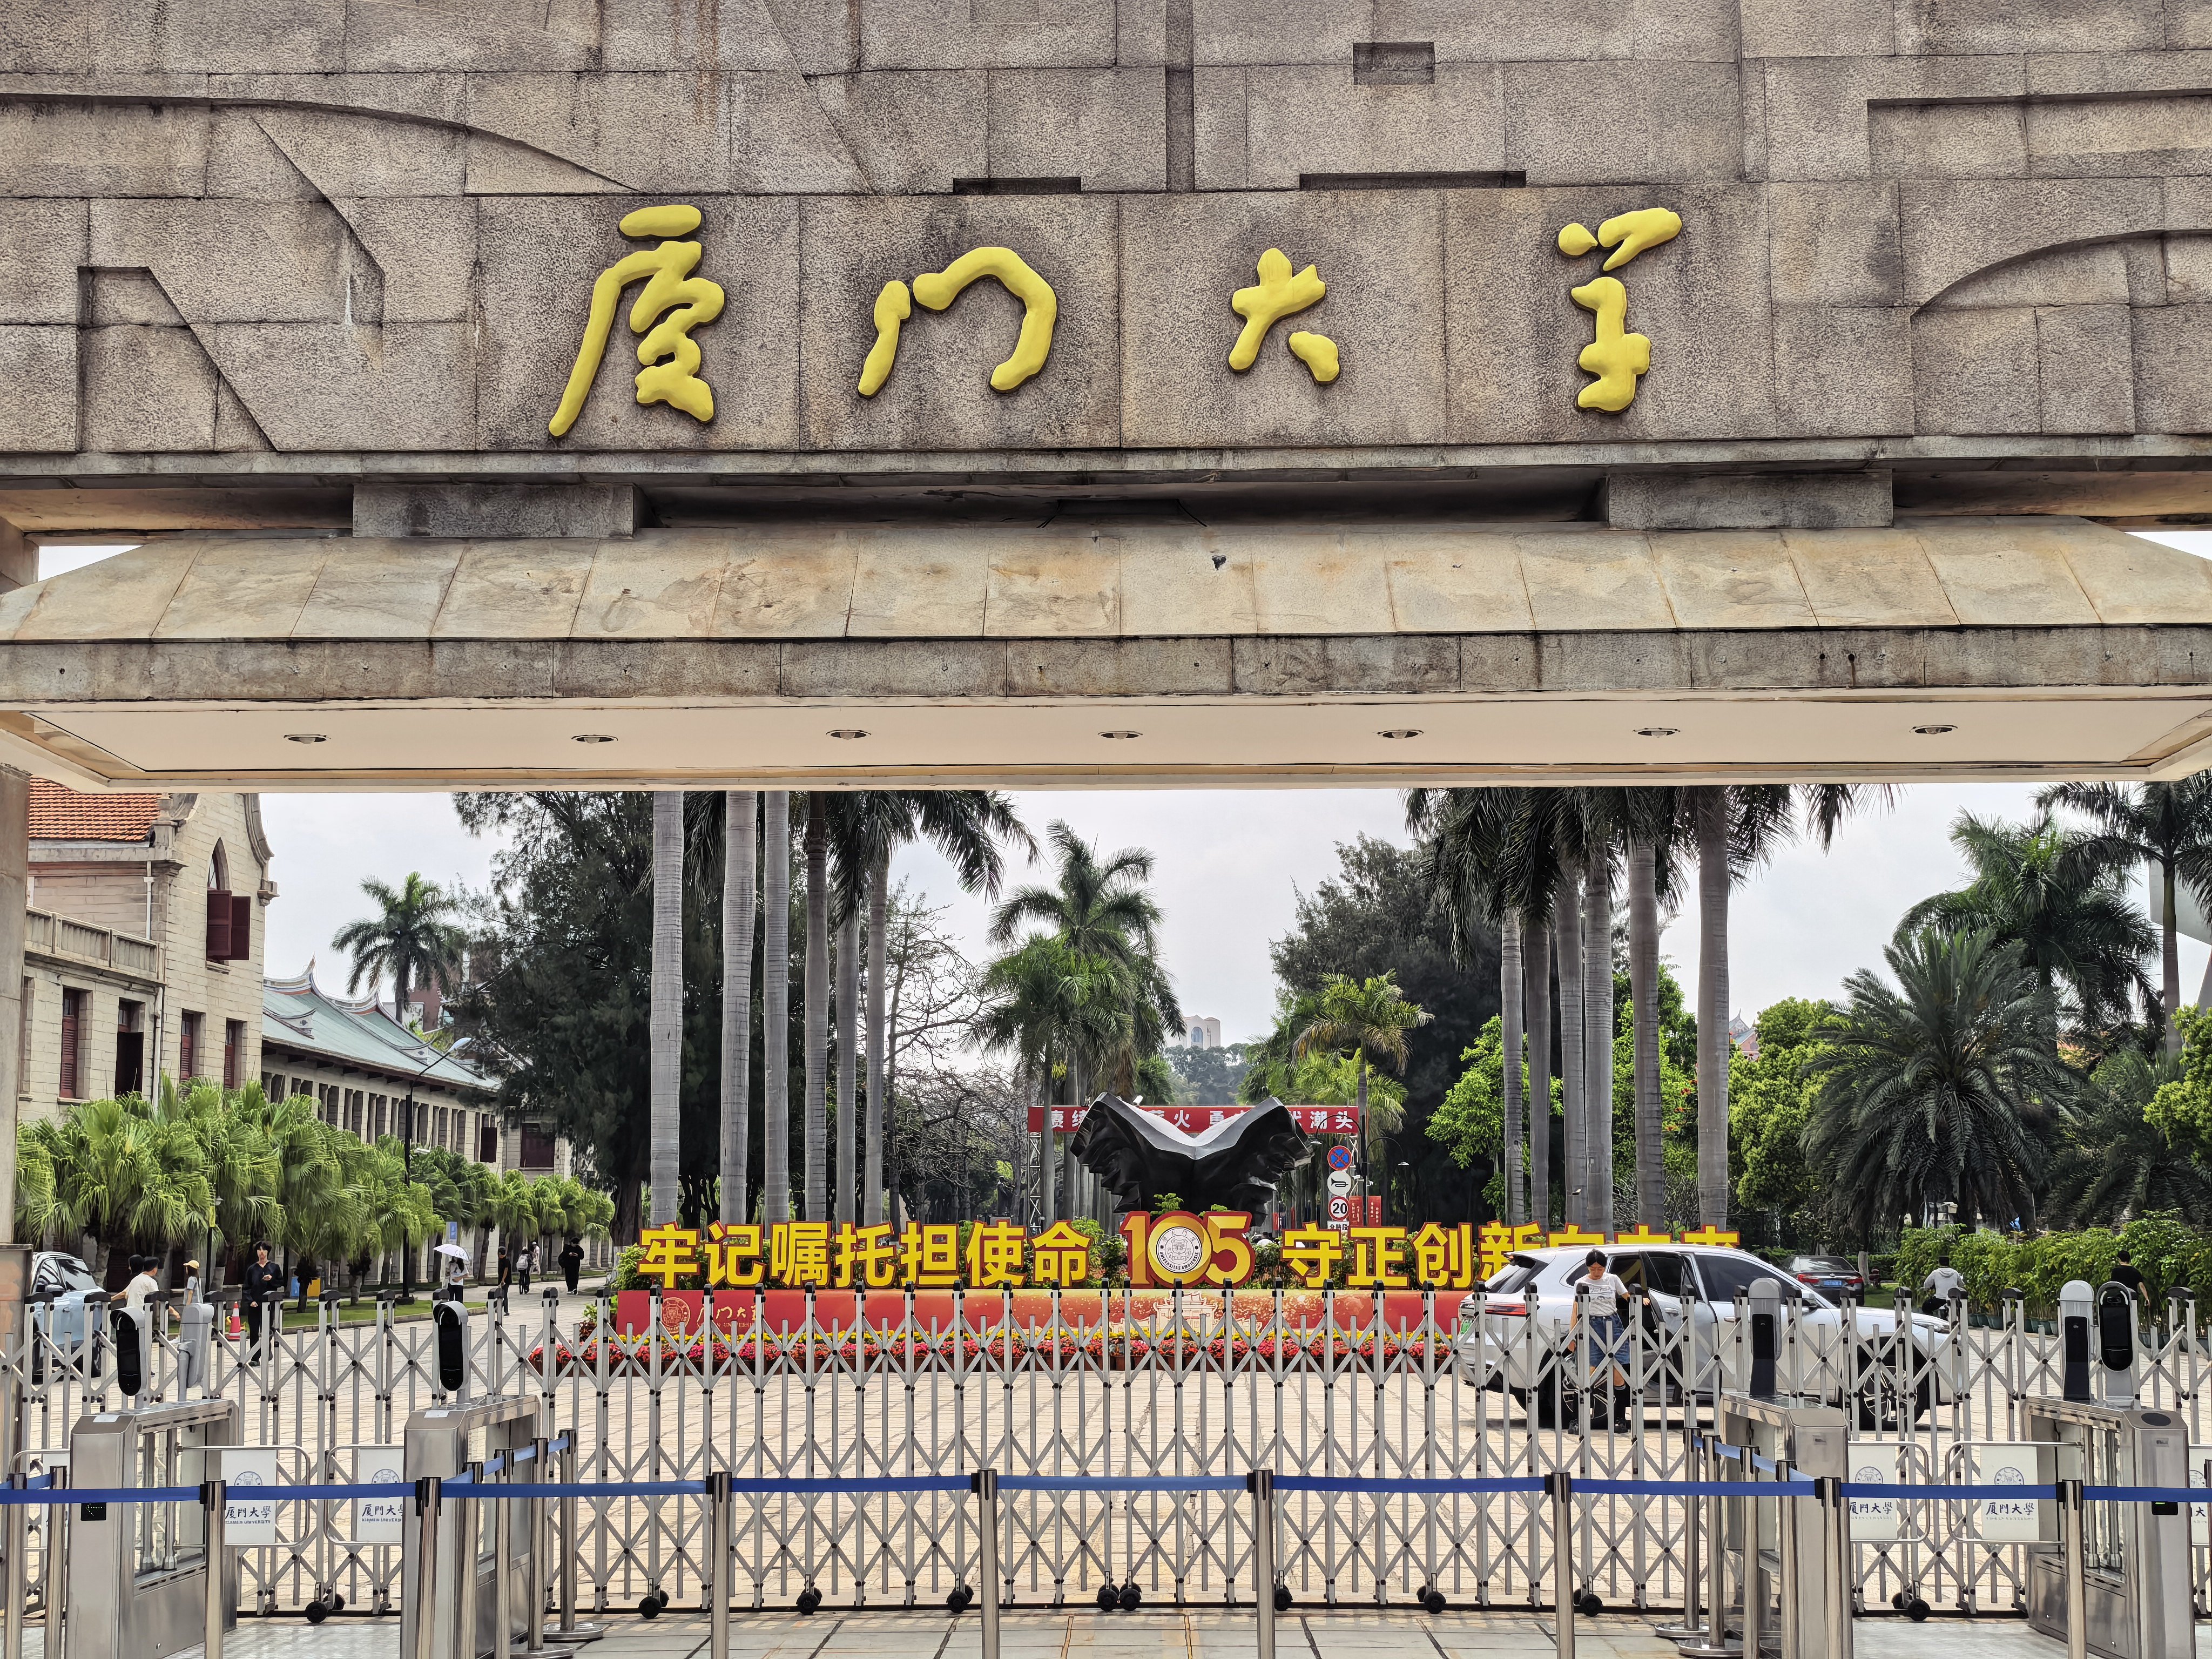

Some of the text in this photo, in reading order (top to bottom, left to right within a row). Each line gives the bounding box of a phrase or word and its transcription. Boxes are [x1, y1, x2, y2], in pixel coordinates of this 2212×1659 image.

[1332, 1203, 1347, 1214] 20
[638, 1219, 1091, 1289] 牢记嘱托担使命
[1120, 1211, 1256, 1289] 105
[1281, 1220, 1739, 1289] 守正创新
